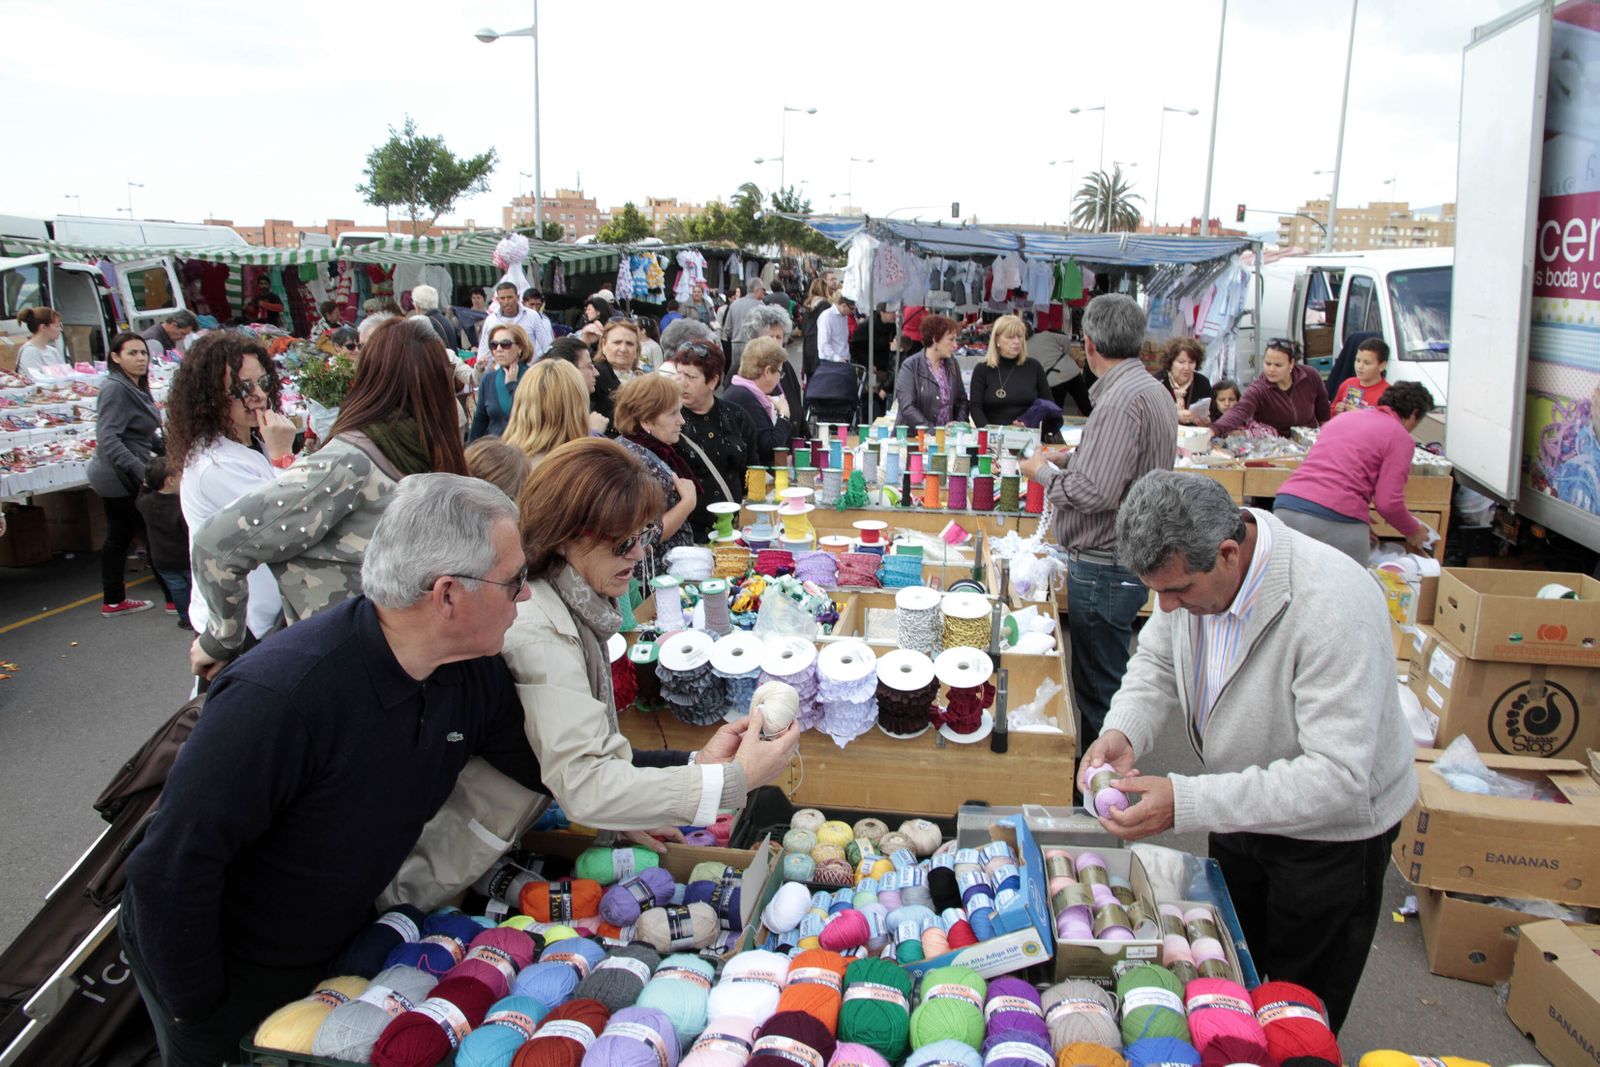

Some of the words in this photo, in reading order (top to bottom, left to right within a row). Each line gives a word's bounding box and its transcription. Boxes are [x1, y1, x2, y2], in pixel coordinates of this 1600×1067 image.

[1537, 217, 1600, 264] cer
[1546, 266, 1578, 288] boda
[1581, 271, 1591, 294] y
[1511, 734, 1553, 755] Stop
[1485, 852, 1560, 870] BANANAS
[970, 956, 985, 965] Alto
[986, 951, 1005, 961] Adige
[1548, 1005, 1600, 1065] BANANAS
